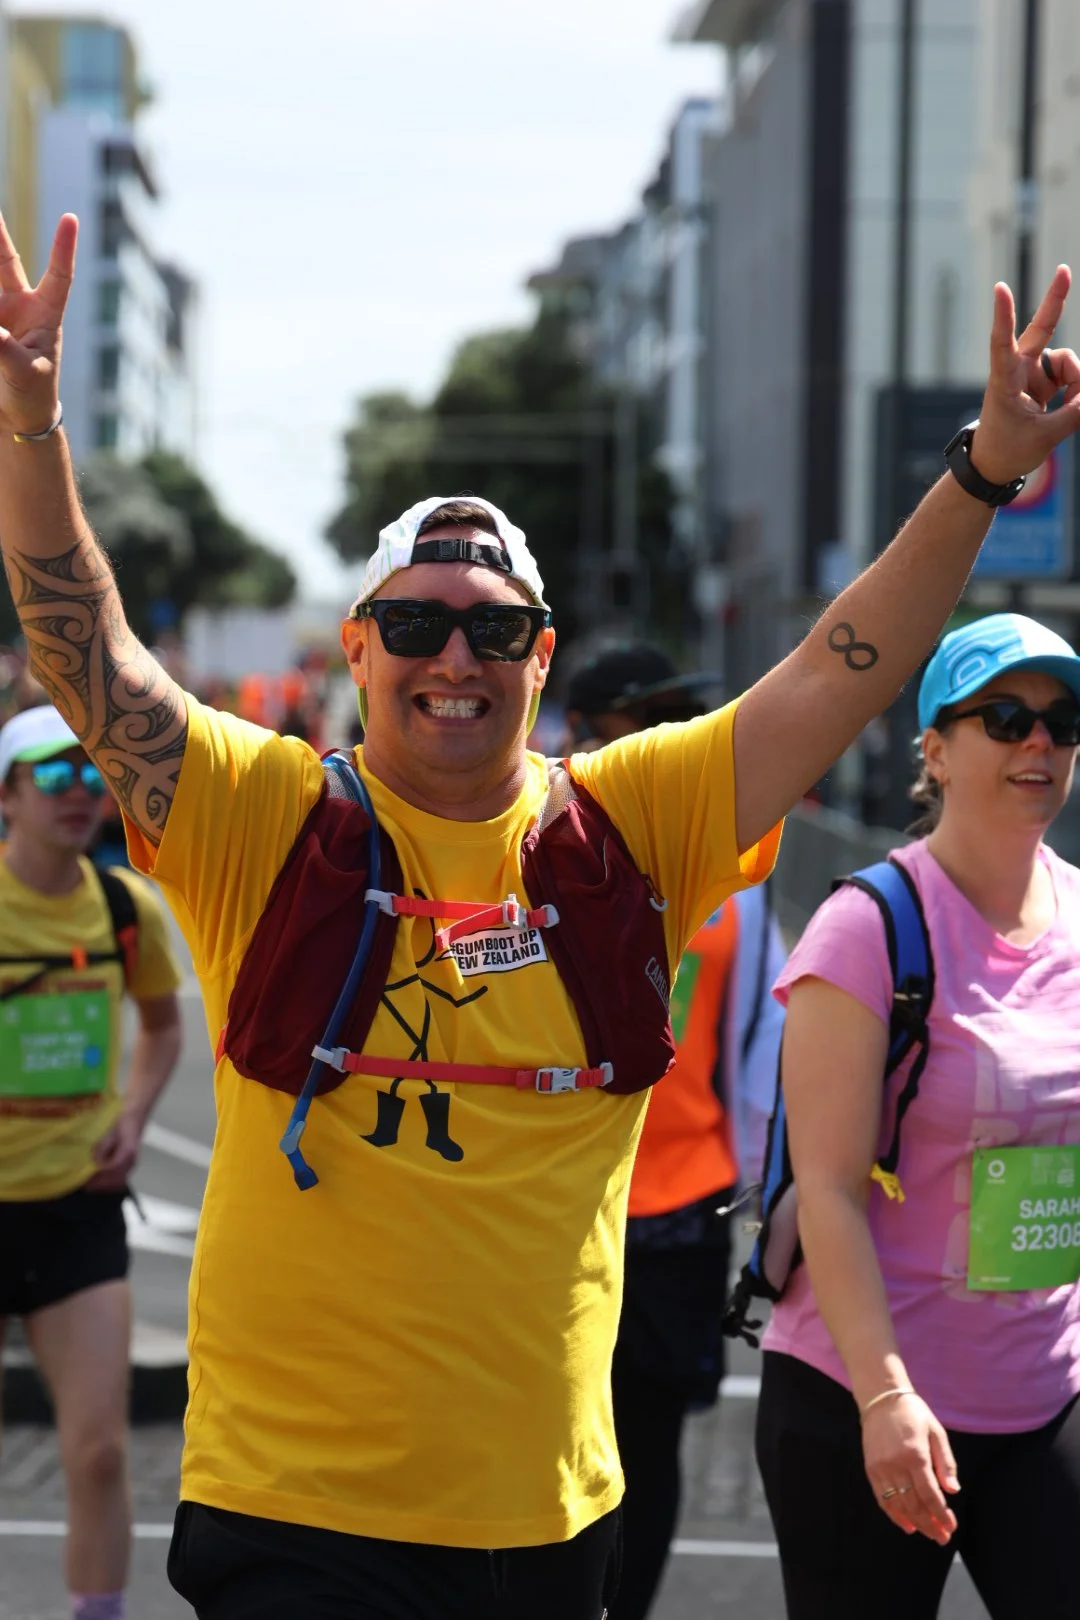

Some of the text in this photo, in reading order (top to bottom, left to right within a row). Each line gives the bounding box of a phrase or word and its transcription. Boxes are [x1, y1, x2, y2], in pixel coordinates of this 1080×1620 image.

[450, 929, 537, 956] #GUMBOOT UP
[454, 942, 541, 970] EW ZEALAND
[1019, 1196, 1080, 1219] SARAH
